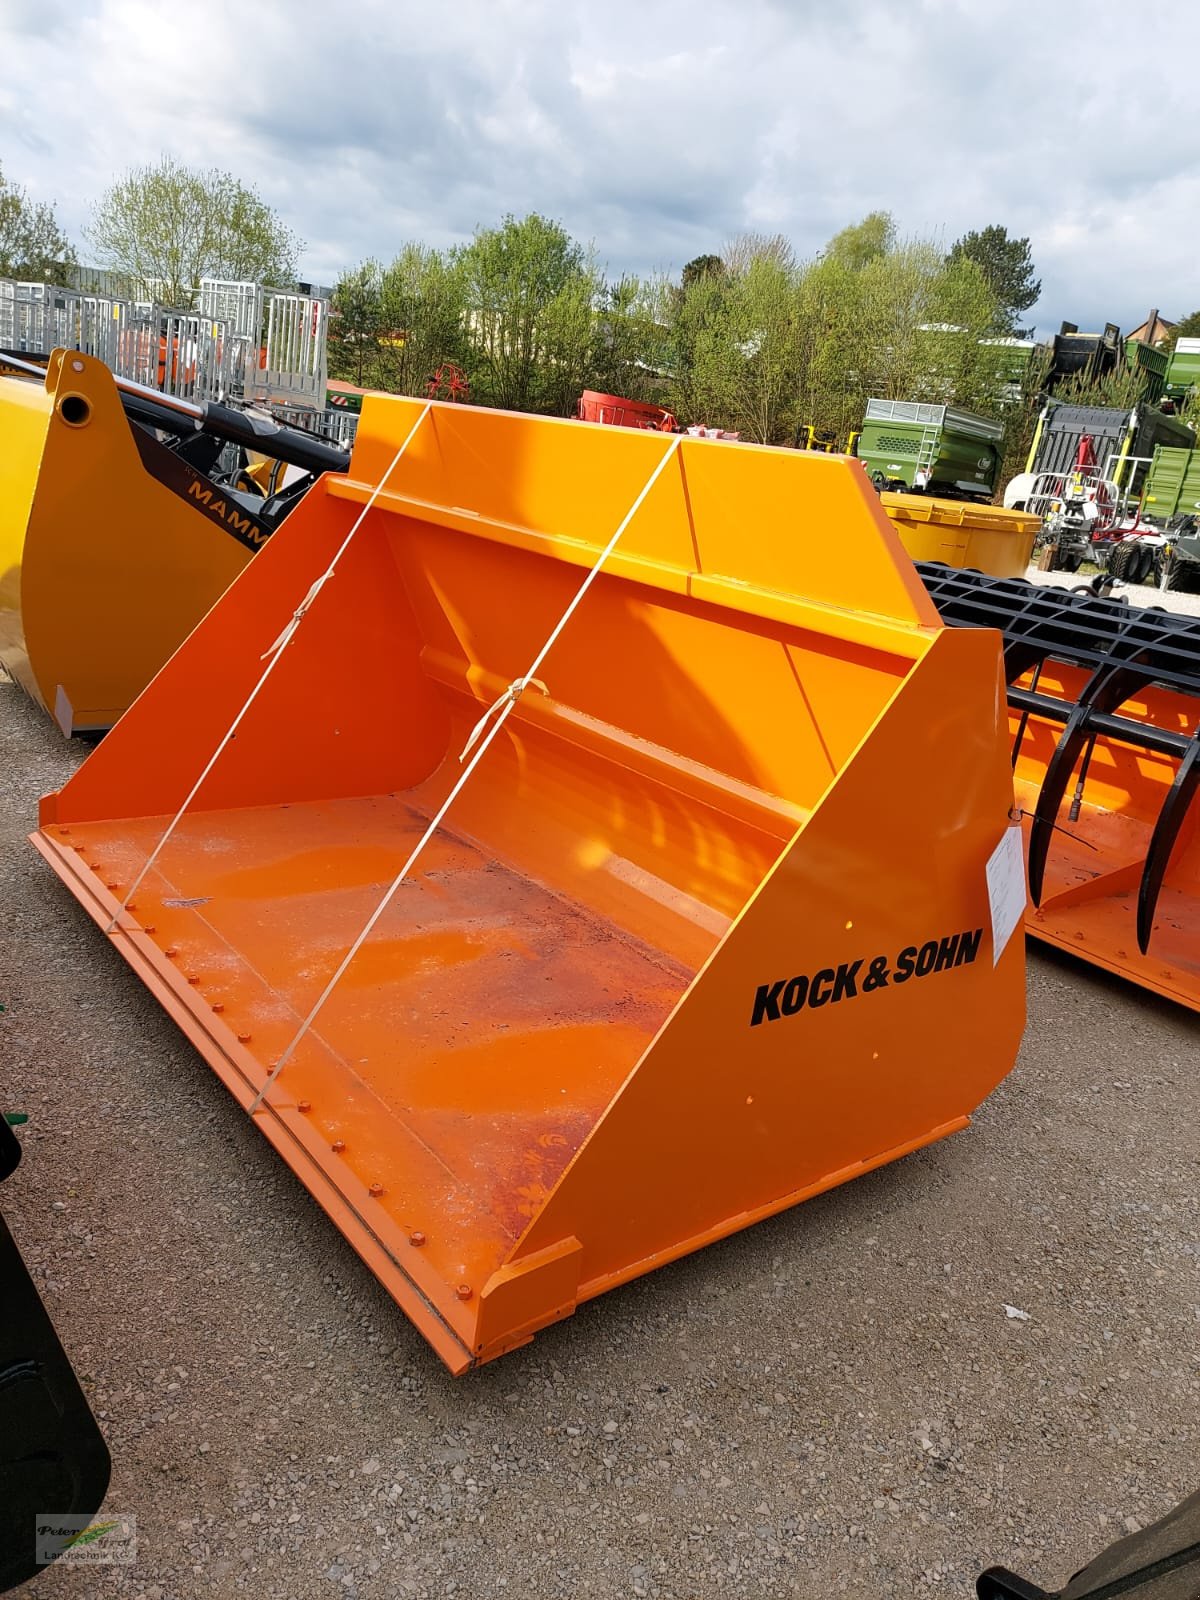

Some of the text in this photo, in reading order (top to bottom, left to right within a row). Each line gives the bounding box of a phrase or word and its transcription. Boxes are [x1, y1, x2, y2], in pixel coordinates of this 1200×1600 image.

[750, 928, 984, 1026] KOCK & SOHN
